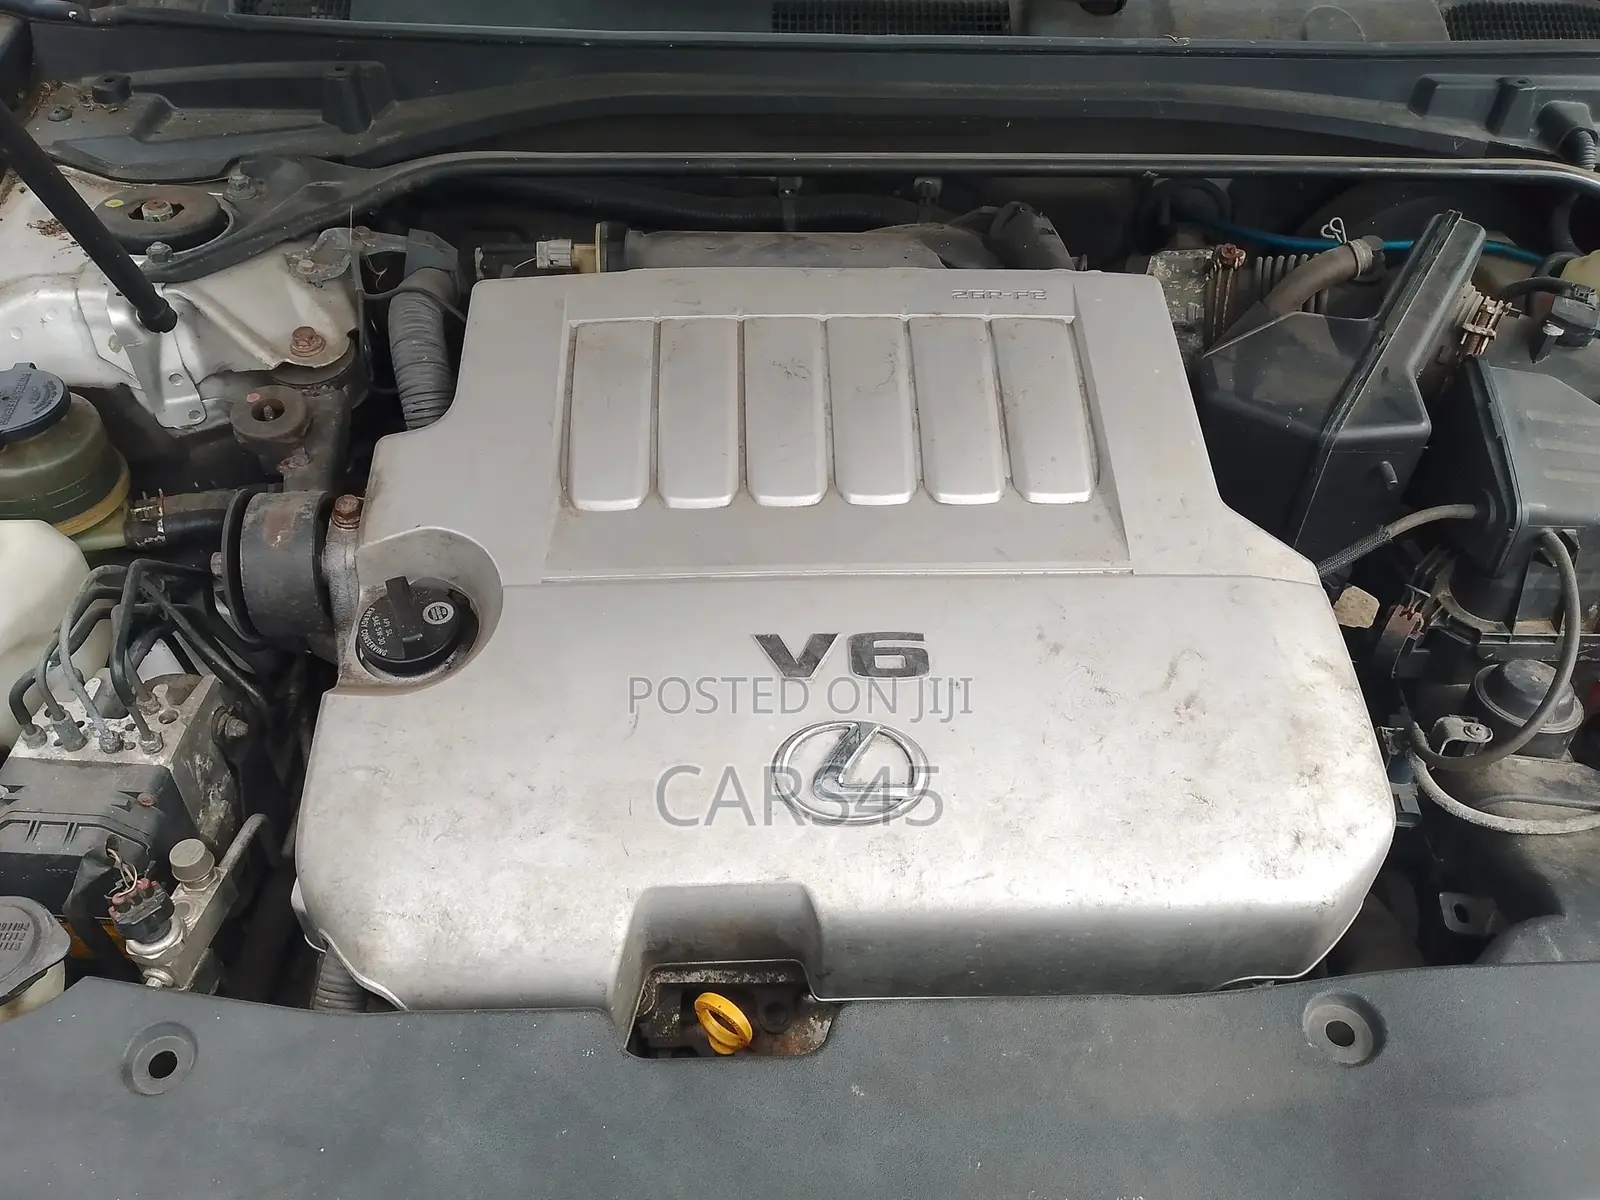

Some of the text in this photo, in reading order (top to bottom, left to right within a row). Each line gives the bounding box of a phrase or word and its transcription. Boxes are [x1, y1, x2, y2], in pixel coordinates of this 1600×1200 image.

[361, 607, 388, 656] ENERGY CONSERVING
[372, 615, 386, 645] SAE 5W-30
[753, 632, 931, 681] V6
